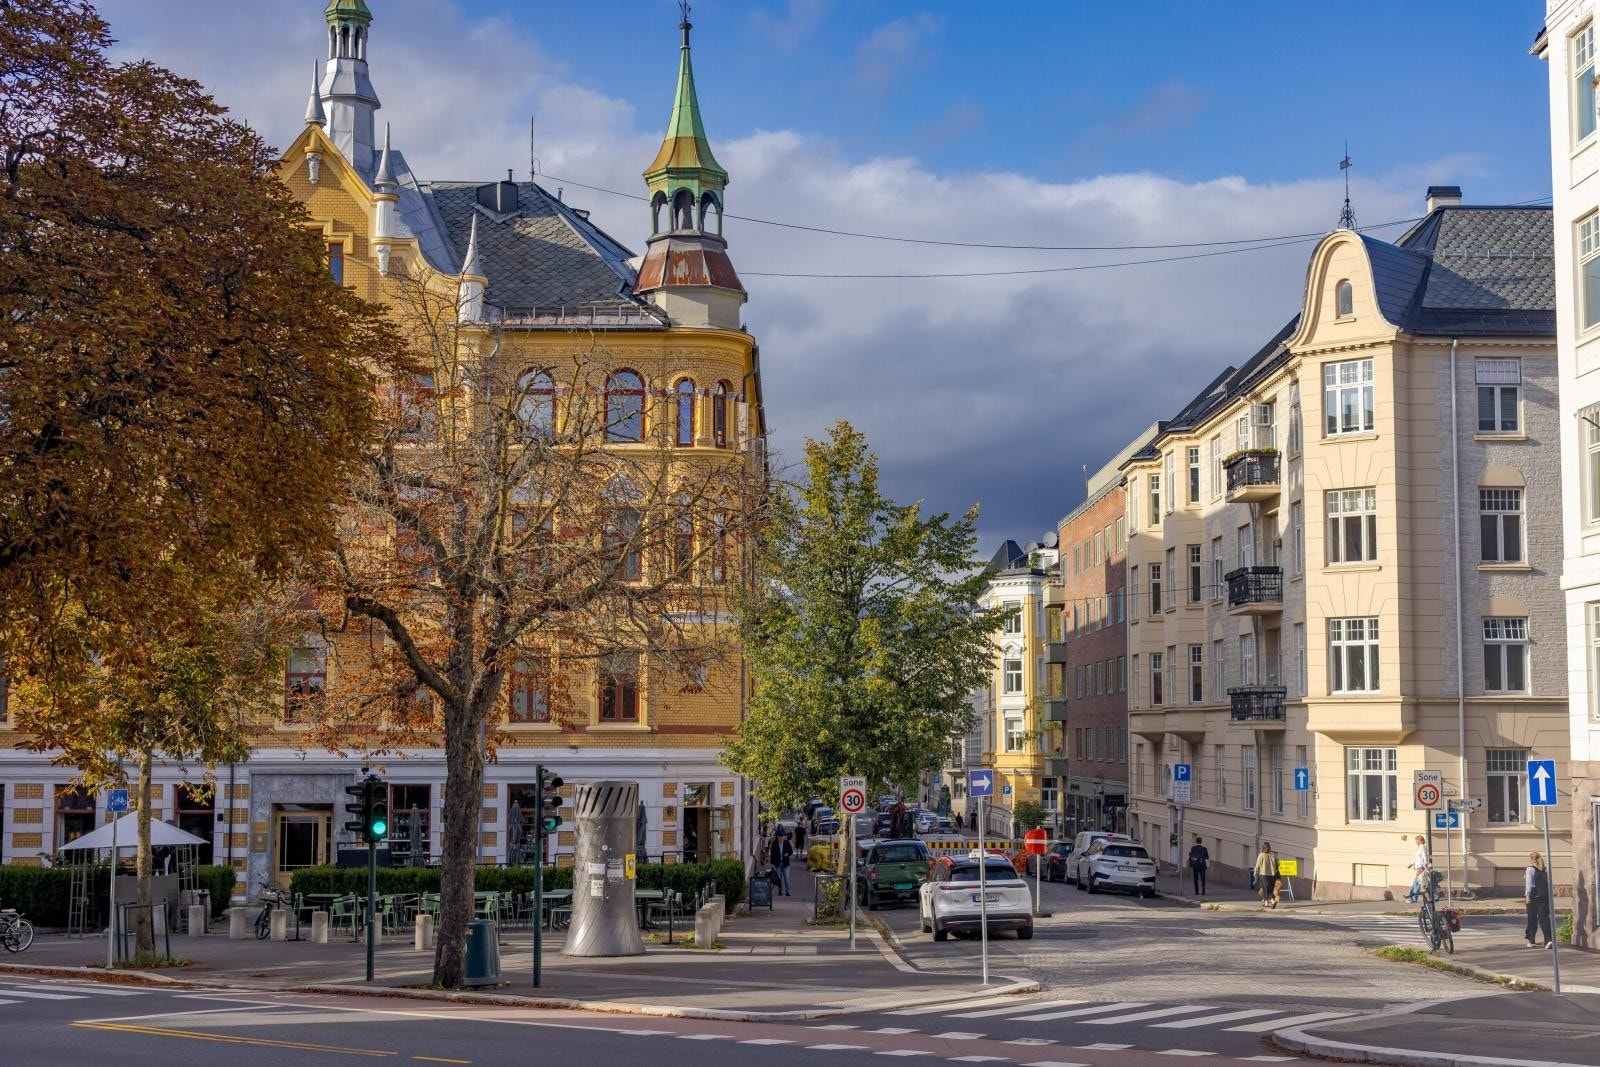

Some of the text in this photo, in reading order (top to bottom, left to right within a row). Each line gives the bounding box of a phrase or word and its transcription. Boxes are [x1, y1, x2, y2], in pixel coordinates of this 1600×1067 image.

[1178, 766, 1187, 779] P
[1418, 773, 1438, 781] Sone
[843, 779, 864, 787] Sone
[846, 795, 861, 807] 30
[1422, 790, 1436, 801] 30
